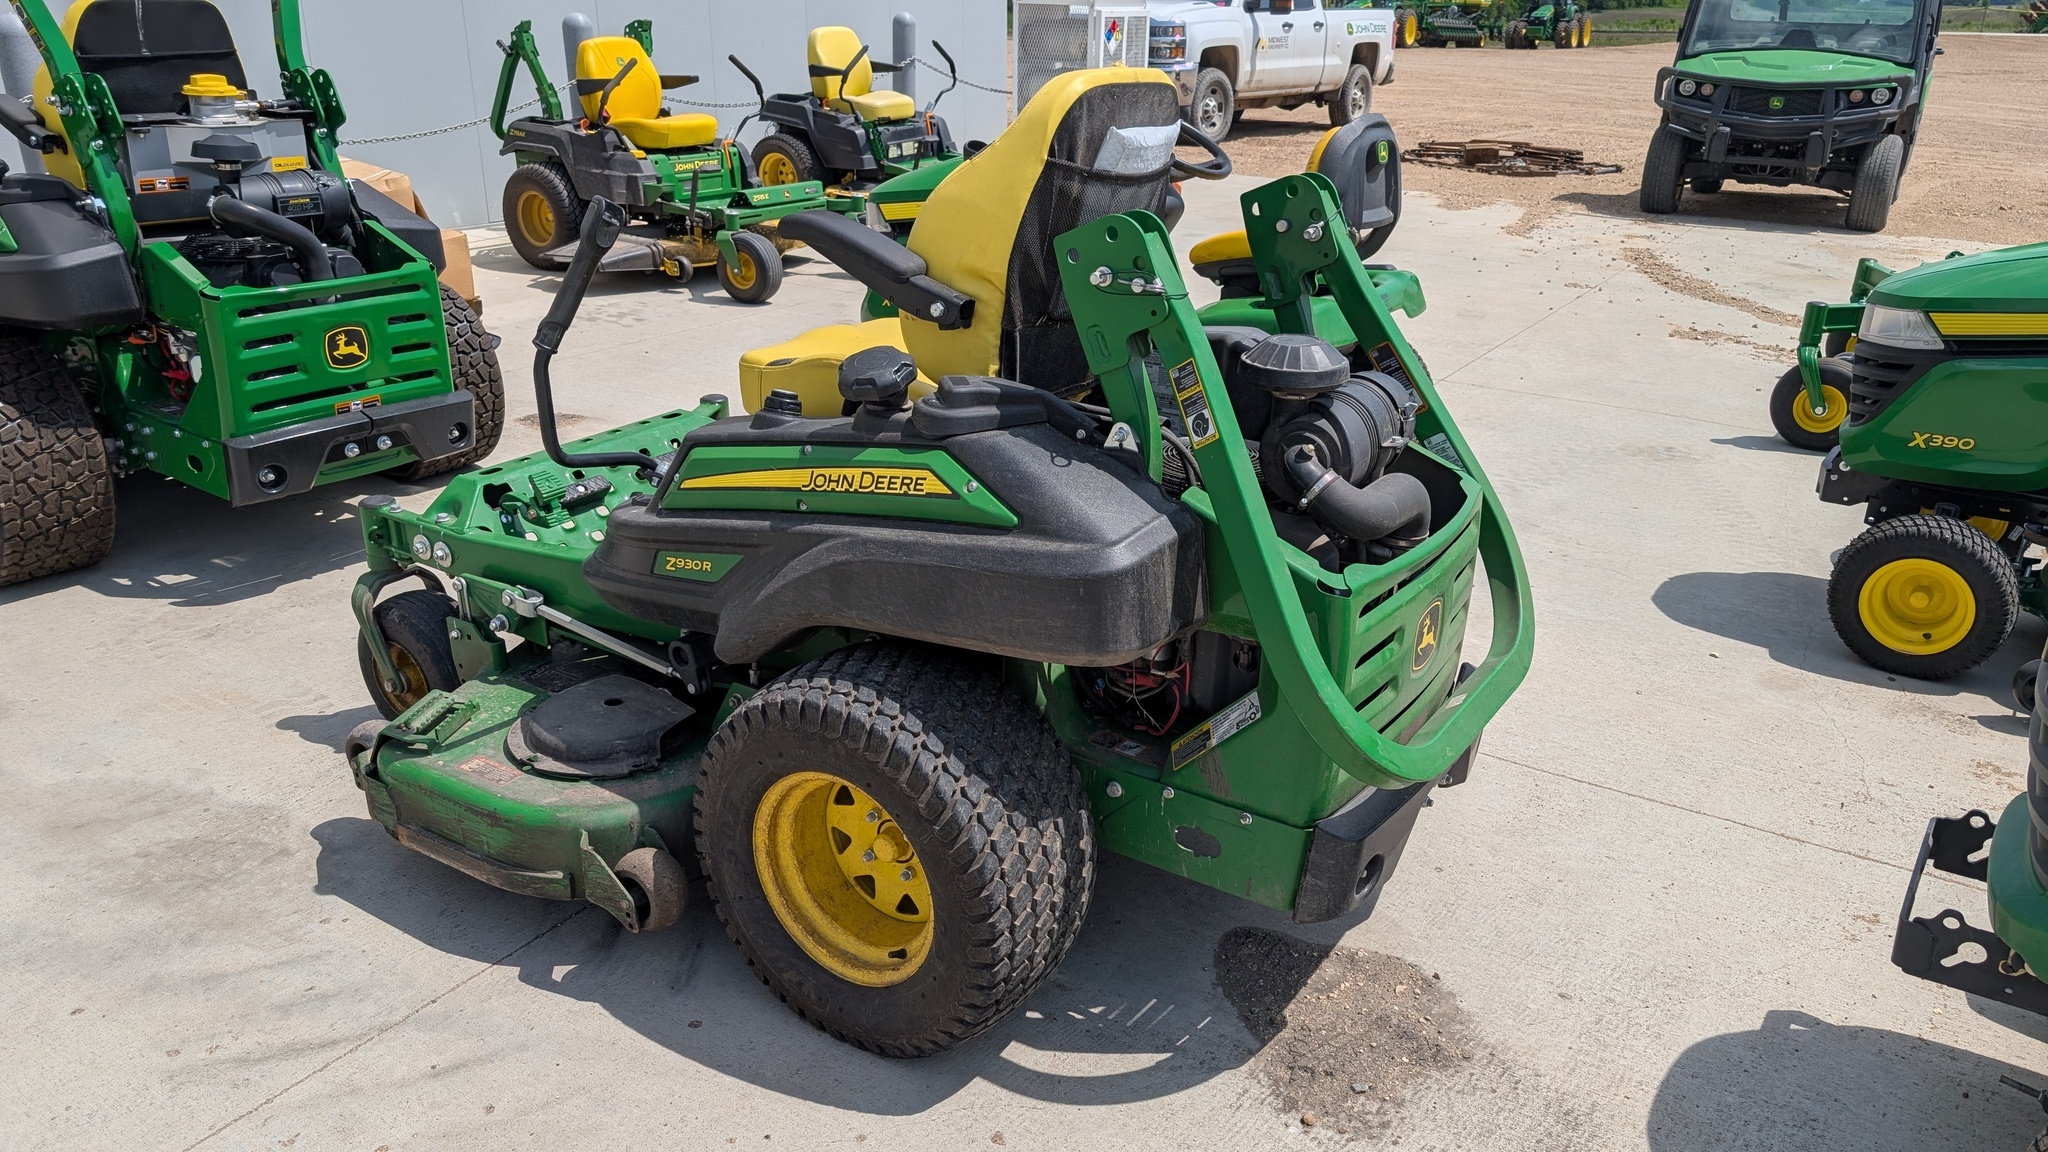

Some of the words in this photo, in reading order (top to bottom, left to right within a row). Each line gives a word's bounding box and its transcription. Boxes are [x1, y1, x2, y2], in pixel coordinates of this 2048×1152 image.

[1355, 23, 1370, 34] JOHN
[1370, 22, 1387, 33] DEERE
[674, 162, 694, 171] JOHN
[1906, 431, 1976, 450] X390
[801, 471, 856, 494] JOHN
[858, 470, 927, 496] DEERE
[665, 557, 712, 572] Z930R
